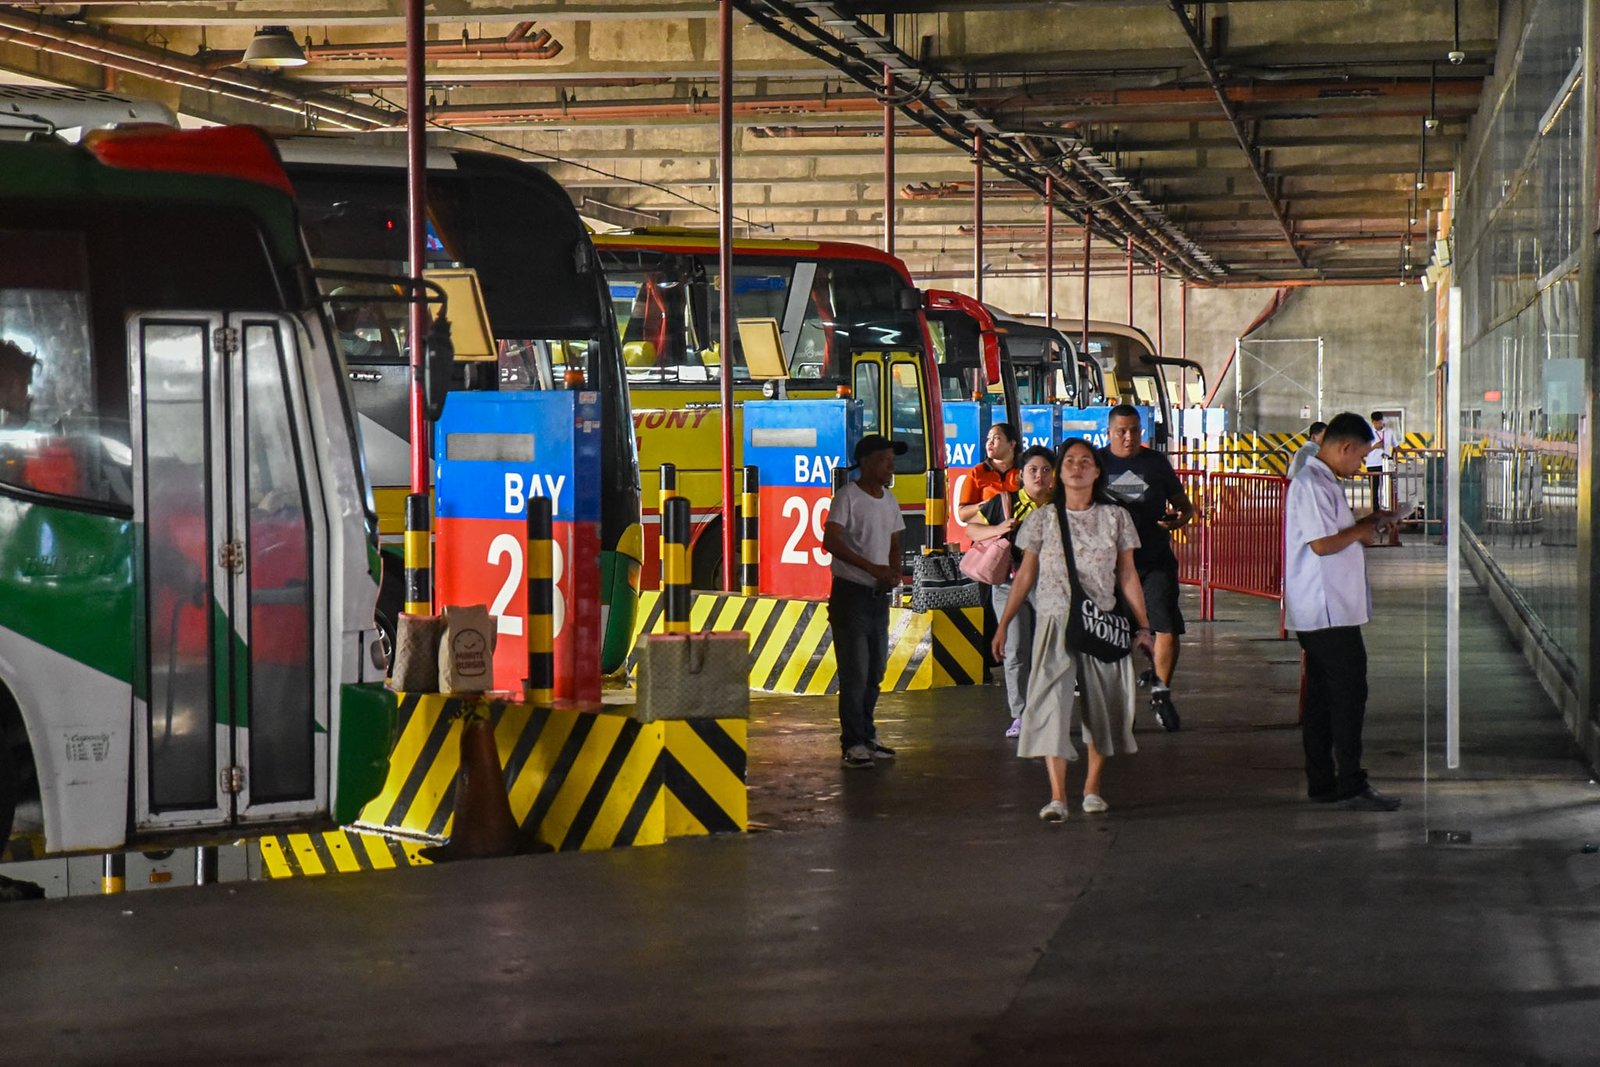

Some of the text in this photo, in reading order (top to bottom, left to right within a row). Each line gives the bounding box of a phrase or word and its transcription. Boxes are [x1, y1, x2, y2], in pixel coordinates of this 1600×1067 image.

[944, 443, 976, 465] BAY
[795, 455, 840, 483] BAY
[781, 496, 833, 567] 29
